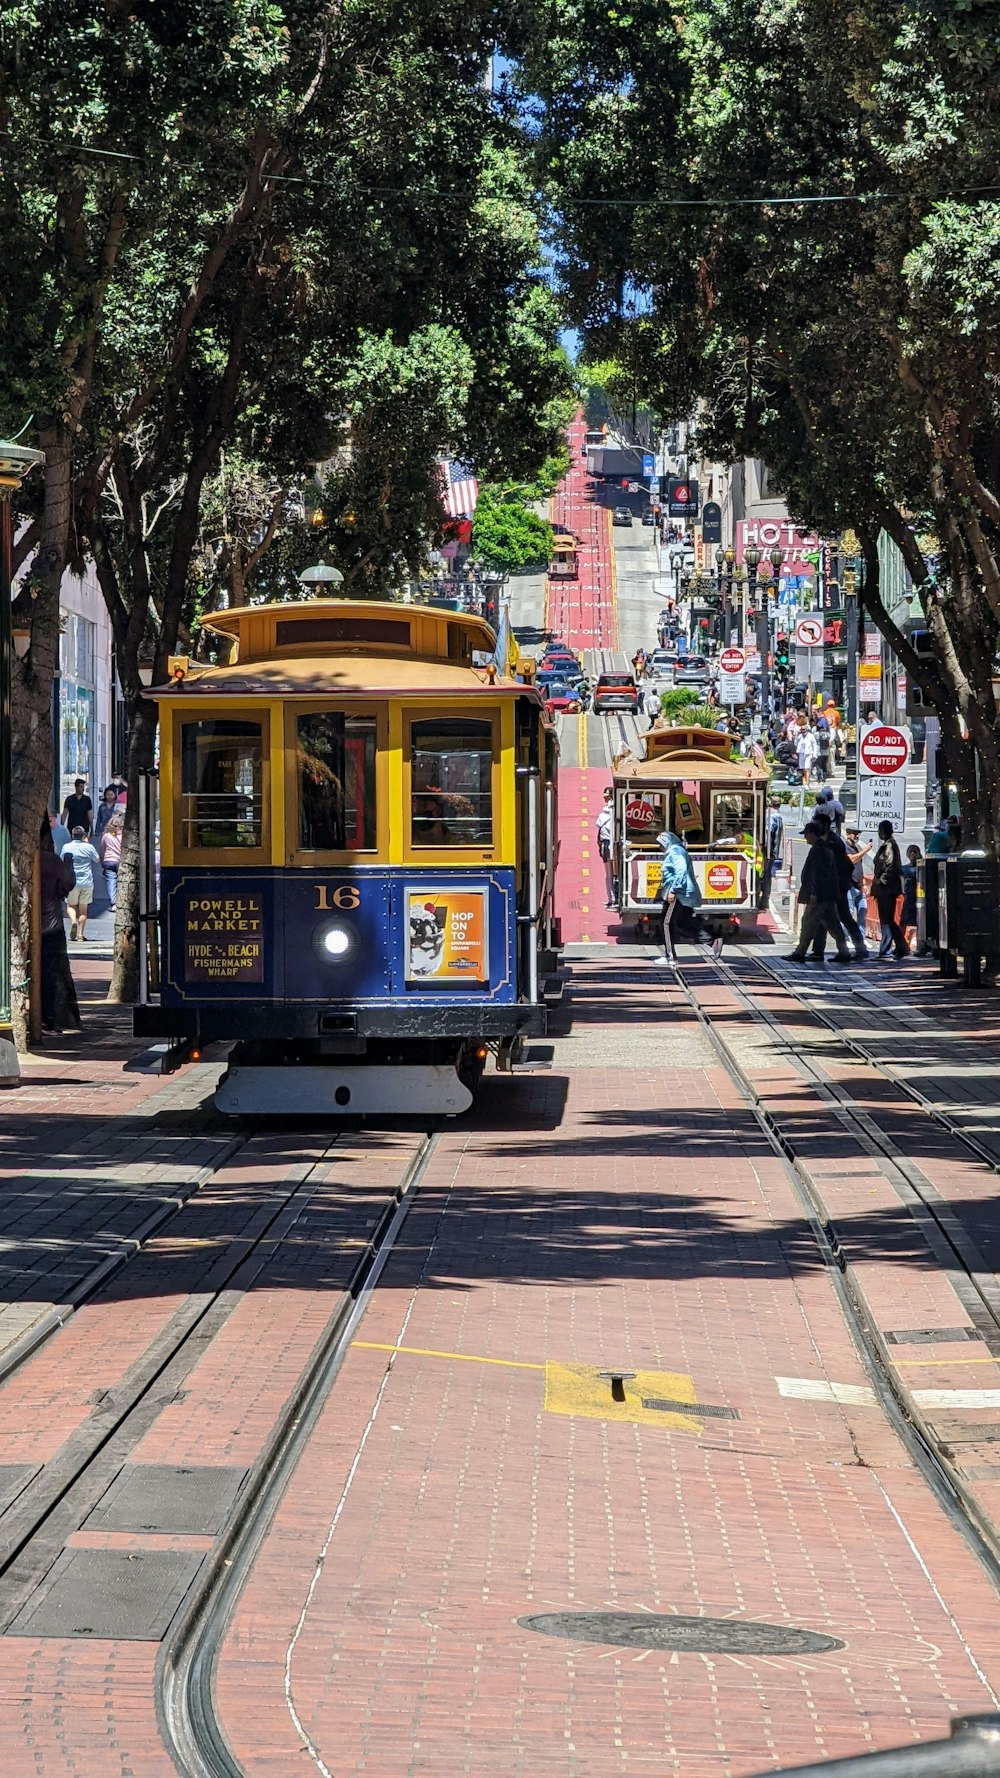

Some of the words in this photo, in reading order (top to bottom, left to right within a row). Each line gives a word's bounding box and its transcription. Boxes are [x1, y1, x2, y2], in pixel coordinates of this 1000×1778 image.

[742, 523, 824, 545] HOT
[868, 735, 880, 744] DO
[885, 736, 902, 745] NOT
[870, 757, 897, 765] ENTER
[869, 779, 896, 788] EXCEPT
[873, 790, 891, 798] MUNI
[872, 800, 892, 809] TAXIS
[626, 807, 654, 819] STOP
[861, 810, 902, 819] COMMERCIAL
[314, 885, 360, 910] 16
[189, 900, 259, 911] POWELL
[207, 911, 242, 919] AND
[451, 912, 474, 921] HOP
[187, 920, 260, 931] MARKET
[451, 922, 467, 931] ON
[451, 932, 465, 940] TO
[188, 945, 213, 957] HYDE
[227, 944, 259, 957] BEACH
[194, 958, 253, 968] FISHERMANS
[207, 968, 239, 976] WHARF
